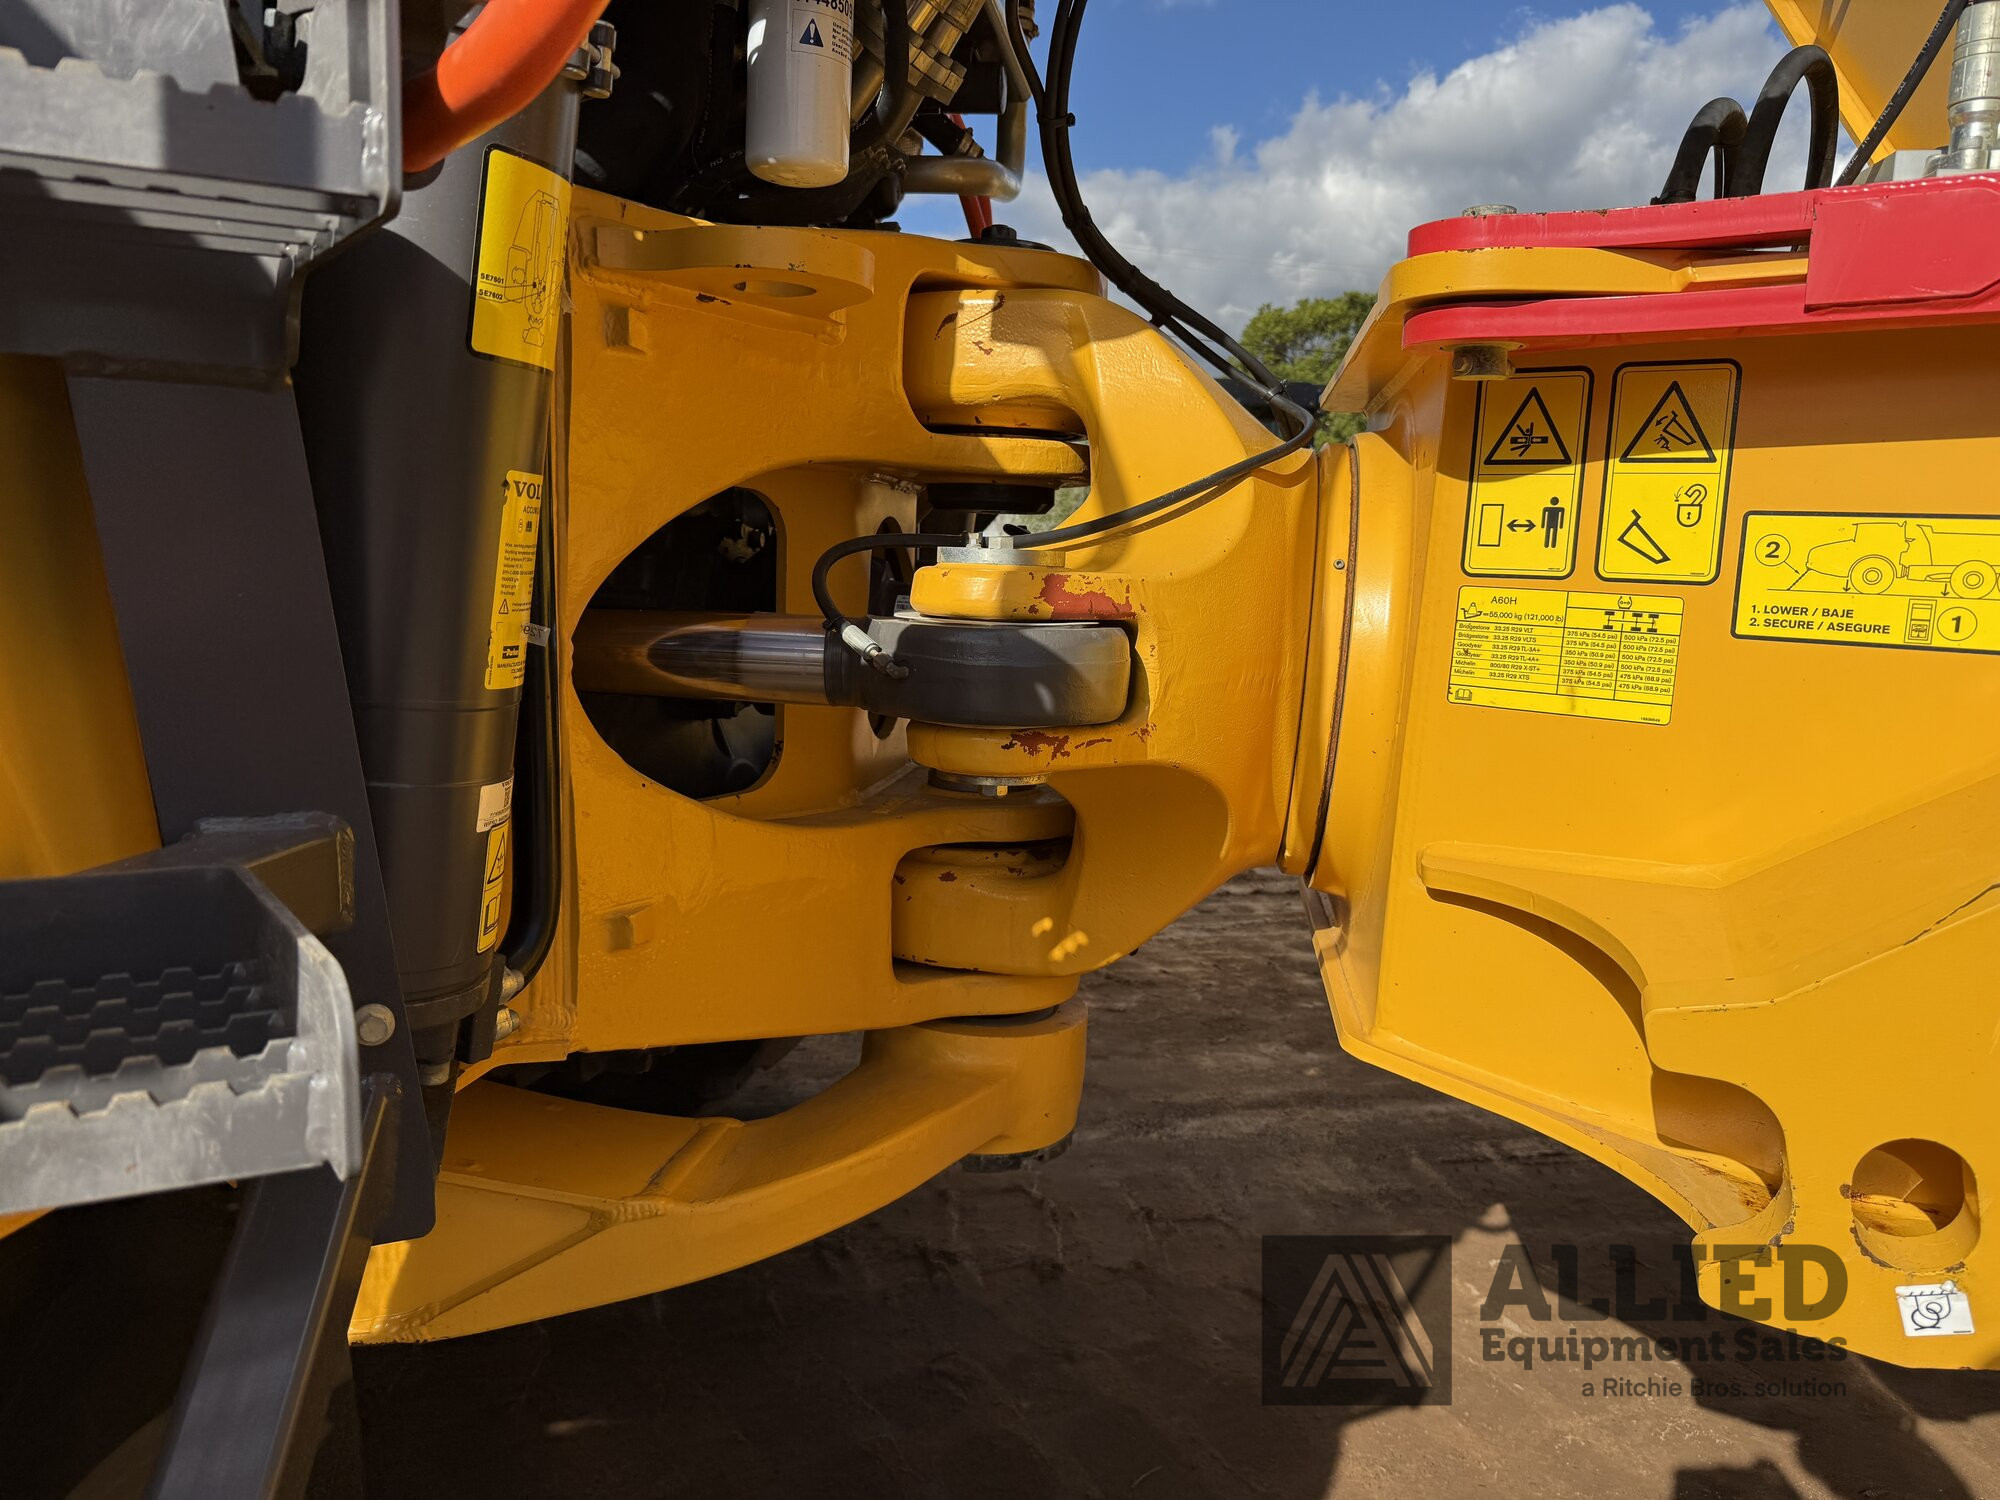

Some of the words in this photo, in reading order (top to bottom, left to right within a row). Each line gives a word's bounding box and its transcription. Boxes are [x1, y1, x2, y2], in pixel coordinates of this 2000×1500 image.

[1764, 542, 1781, 559] 2
[1491, 596, 1517, 605] A60H
[1751, 604, 1760, 614] 1.
[1764, 605, 1809, 618] LOWER
[1812, 607, 1819, 617] /
[1822, 608, 1854, 619] BAJE
[1459, 623, 1490, 631] Bridgestone
[1749, 617, 1760, 628] 2.
[1763, 618, 1814, 631] SECURE
[1817, 621, 1824, 631] /
[1826, 622, 1891, 635] ASEGURE
[1951, 616, 1962, 633] 1
[1458, 632, 1489, 640] Bridgestone
[1457, 641, 1482, 649] Goodyear
